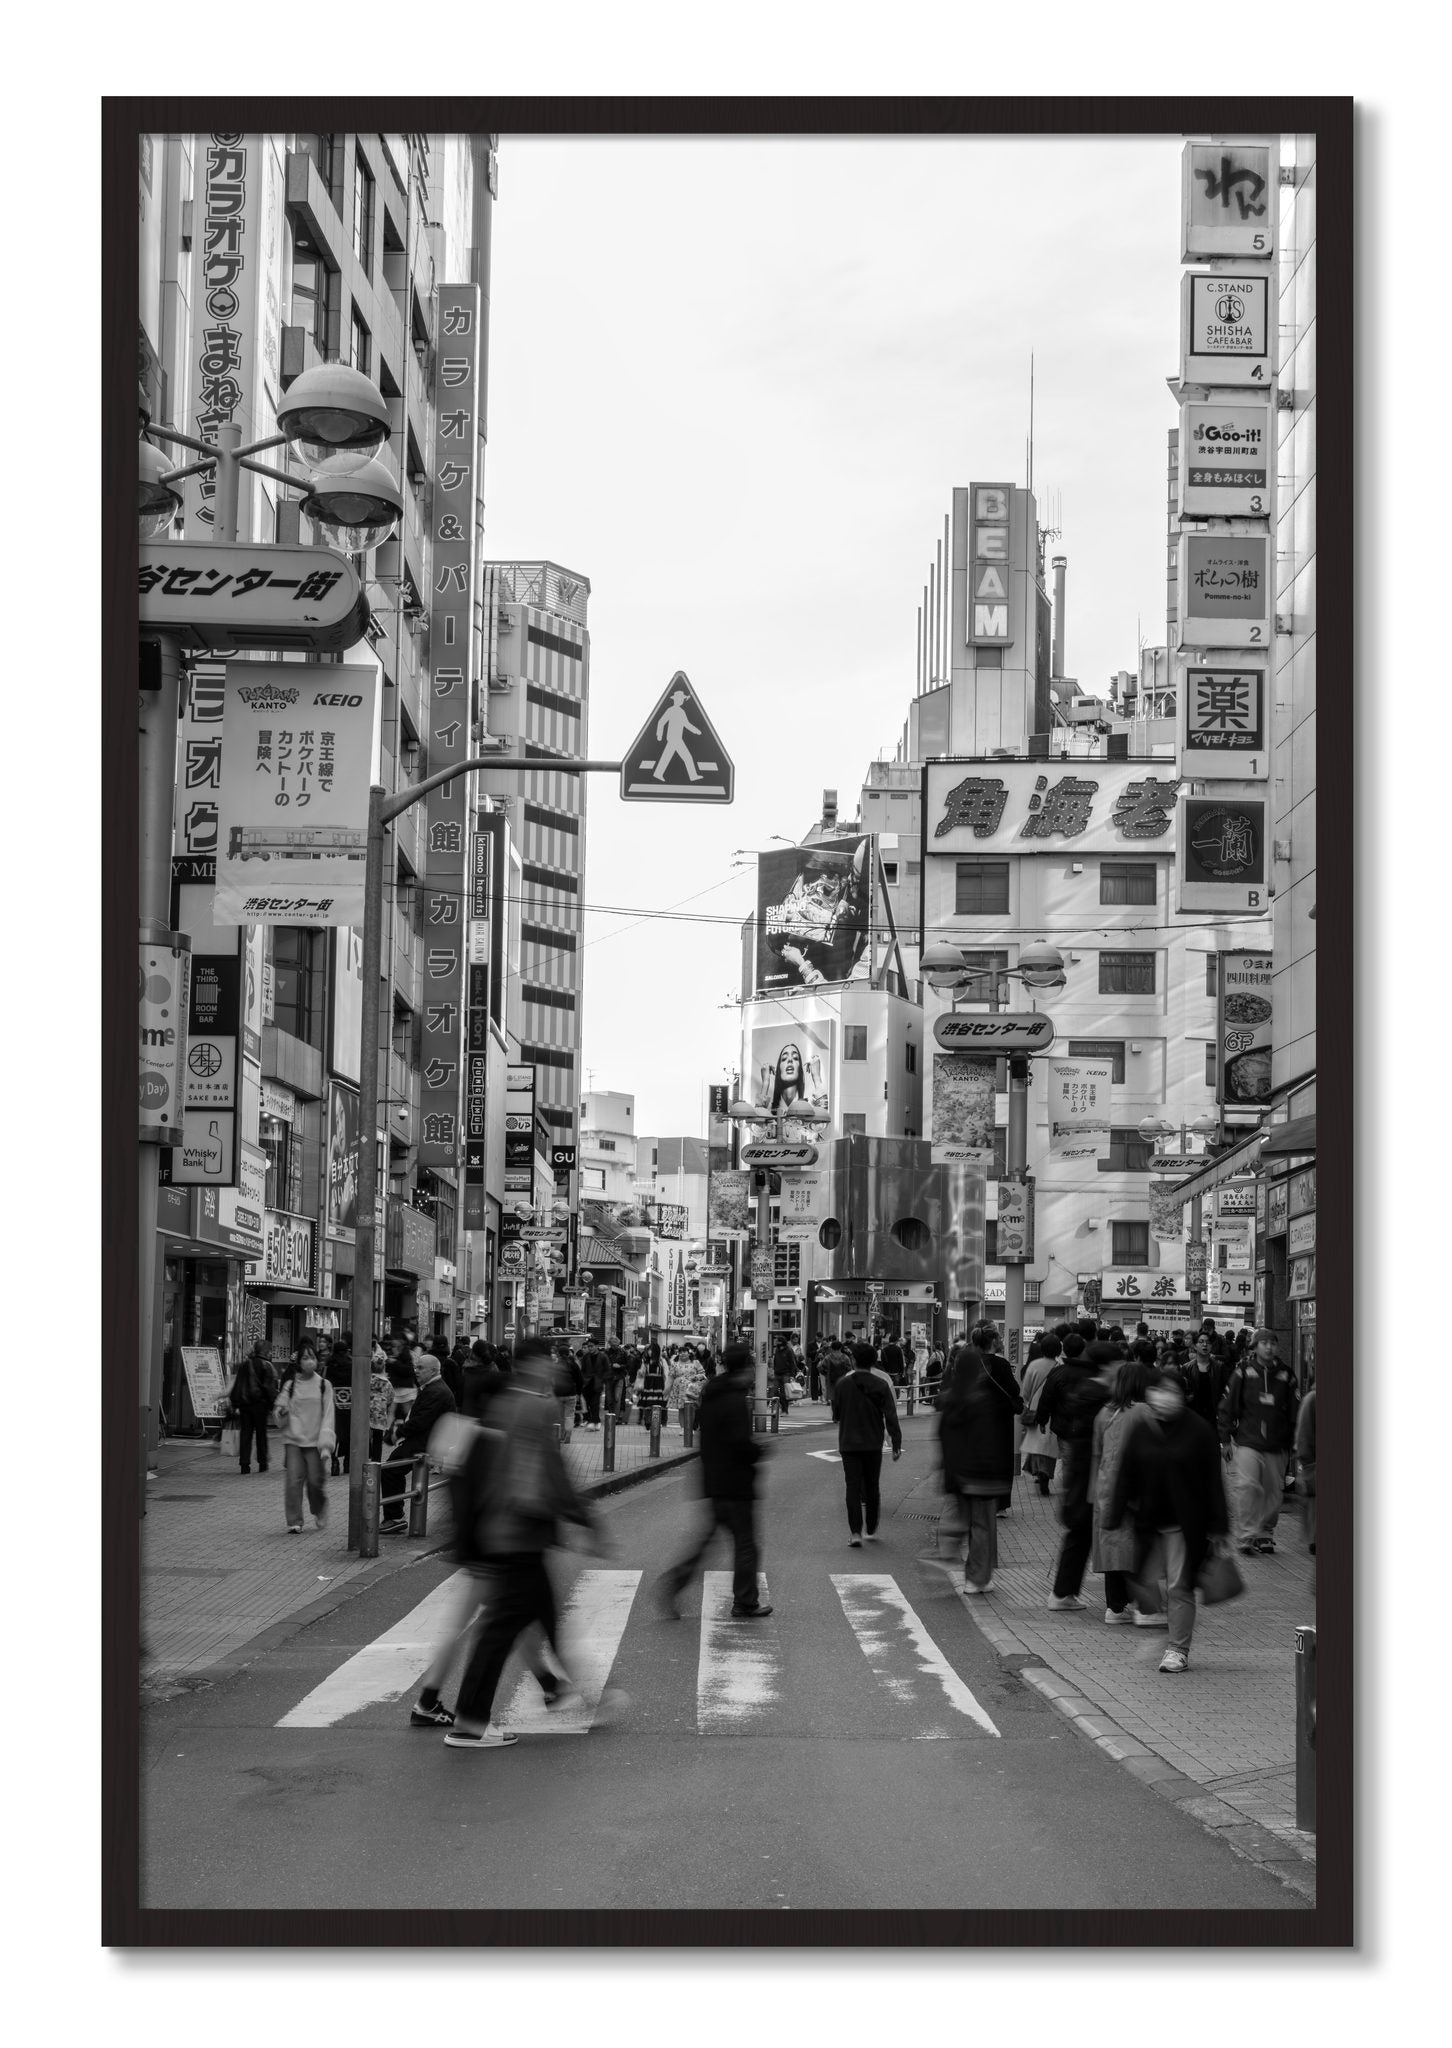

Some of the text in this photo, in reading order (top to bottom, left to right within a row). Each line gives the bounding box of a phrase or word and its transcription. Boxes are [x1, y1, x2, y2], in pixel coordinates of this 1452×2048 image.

[204, 147, 246, 287] カラオケ
[1252, 235, 1265, 249] 5
[1207, 284, 1253, 293] C.STAND
[1207, 326, 1252, 336] SHISHA
[1207, 337, 1252, 345] CAFE&BAR
[1251, 365, 1263, 380] 4
[1205, 426, 1261, 442] Goo-it!
[1198, 446, 1257, 455] 渋谷宇田川町店
[1193, 472, 1262, 484] 全身もみほぐし
[1250, 496, 1262, 512] 3
[975, 488, 1008, 637] BEAM
[1194, 569, 1259, 588] ポムの樹
[1250, 627, 1261, 642] 2
[251, 702, 287, 710] KANTO
[313, 693, 363, 707] KEIO
[1198, 677, 1249, 728] 薬
[256, 730, 272, 774] 冒険へ
[274, 730, 293, 806] カントーの
[318, 731, 335, 792] 京王線で
[1249, 759, 1257, 774] 1
[934, 776, 1178, 838] 角海老
[1192, 816, 1253, 866] 一蘭
[477, 837, 485, 873] kimono
[243, 898, 334, 911] 渋谷センター街
[1248, 891, 1260, 907] B
[1227, 972, 1272, 984] 四川料理
[941, 1022, 1047, 1036] 渋谷センター街
[1225, 1033, 1253, 1051] 6F
[184, 1148, 217, 1160] Whisky
[554, 1152, 574, 1163] GU
[183, 1159, 203, 1167] Bank
[1116, 1275, 1177, 1297] 兆楽
[676, 1273, 685, 1317] BEER
